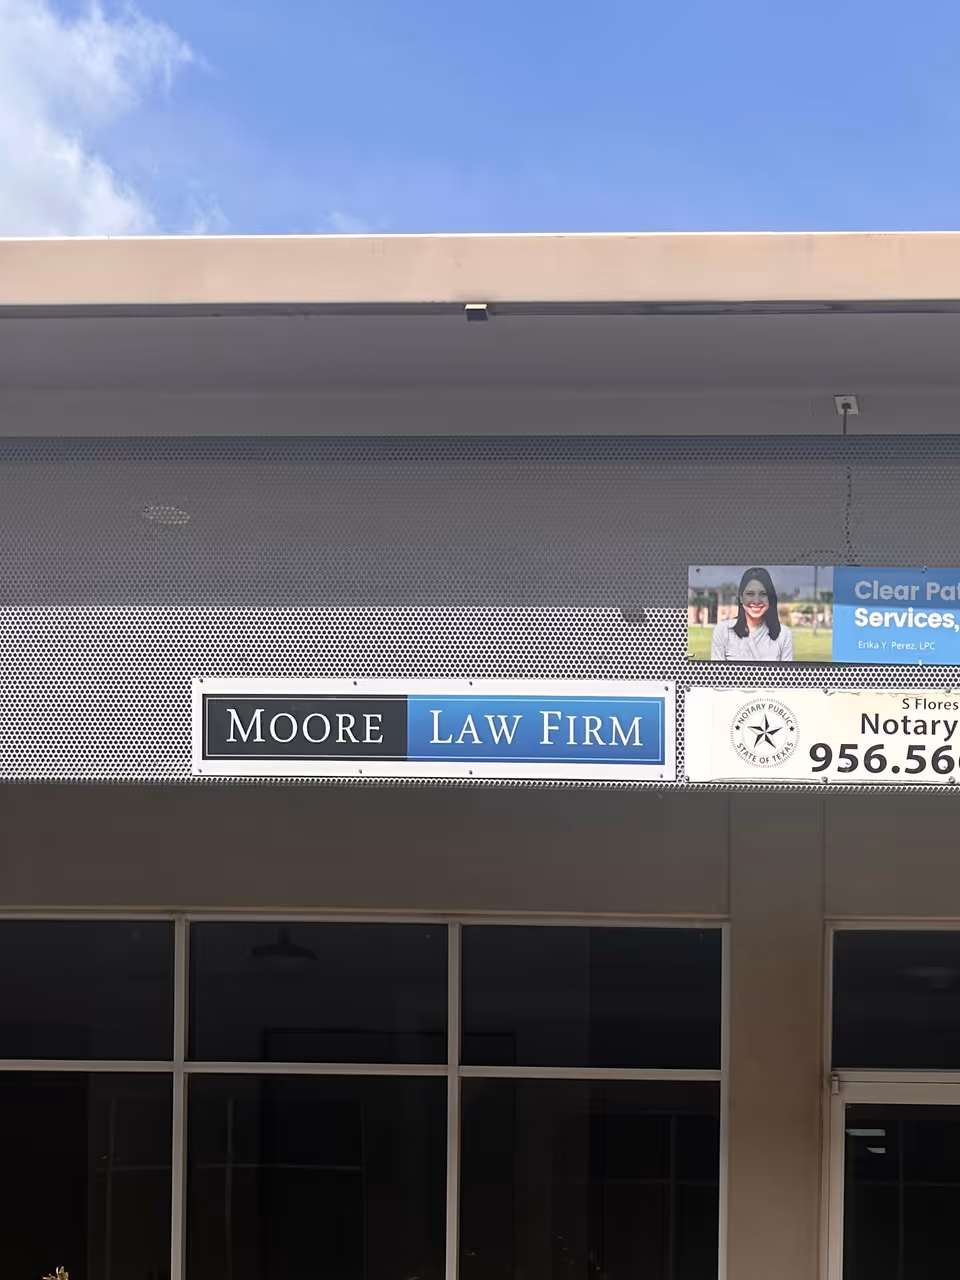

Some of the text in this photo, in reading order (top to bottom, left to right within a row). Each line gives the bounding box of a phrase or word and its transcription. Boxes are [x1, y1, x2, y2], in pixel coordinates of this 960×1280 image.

[855, 580, 919, 602] Clear
[855, 607, 960, 632] Services,
[858, 641, 880, 650] Erika
[891, 642, 917, 651] Perez,
[920, 642, 936, 650] LPC
[738, 703, 792, 726] NOTARY PUBLIC
[902, 699, 910, 709] S
[915, 698, 959, 711] Flores
[861, 713, 958, 741] Notary
[737, 742, 793, 764] STATE OF TEXAS
